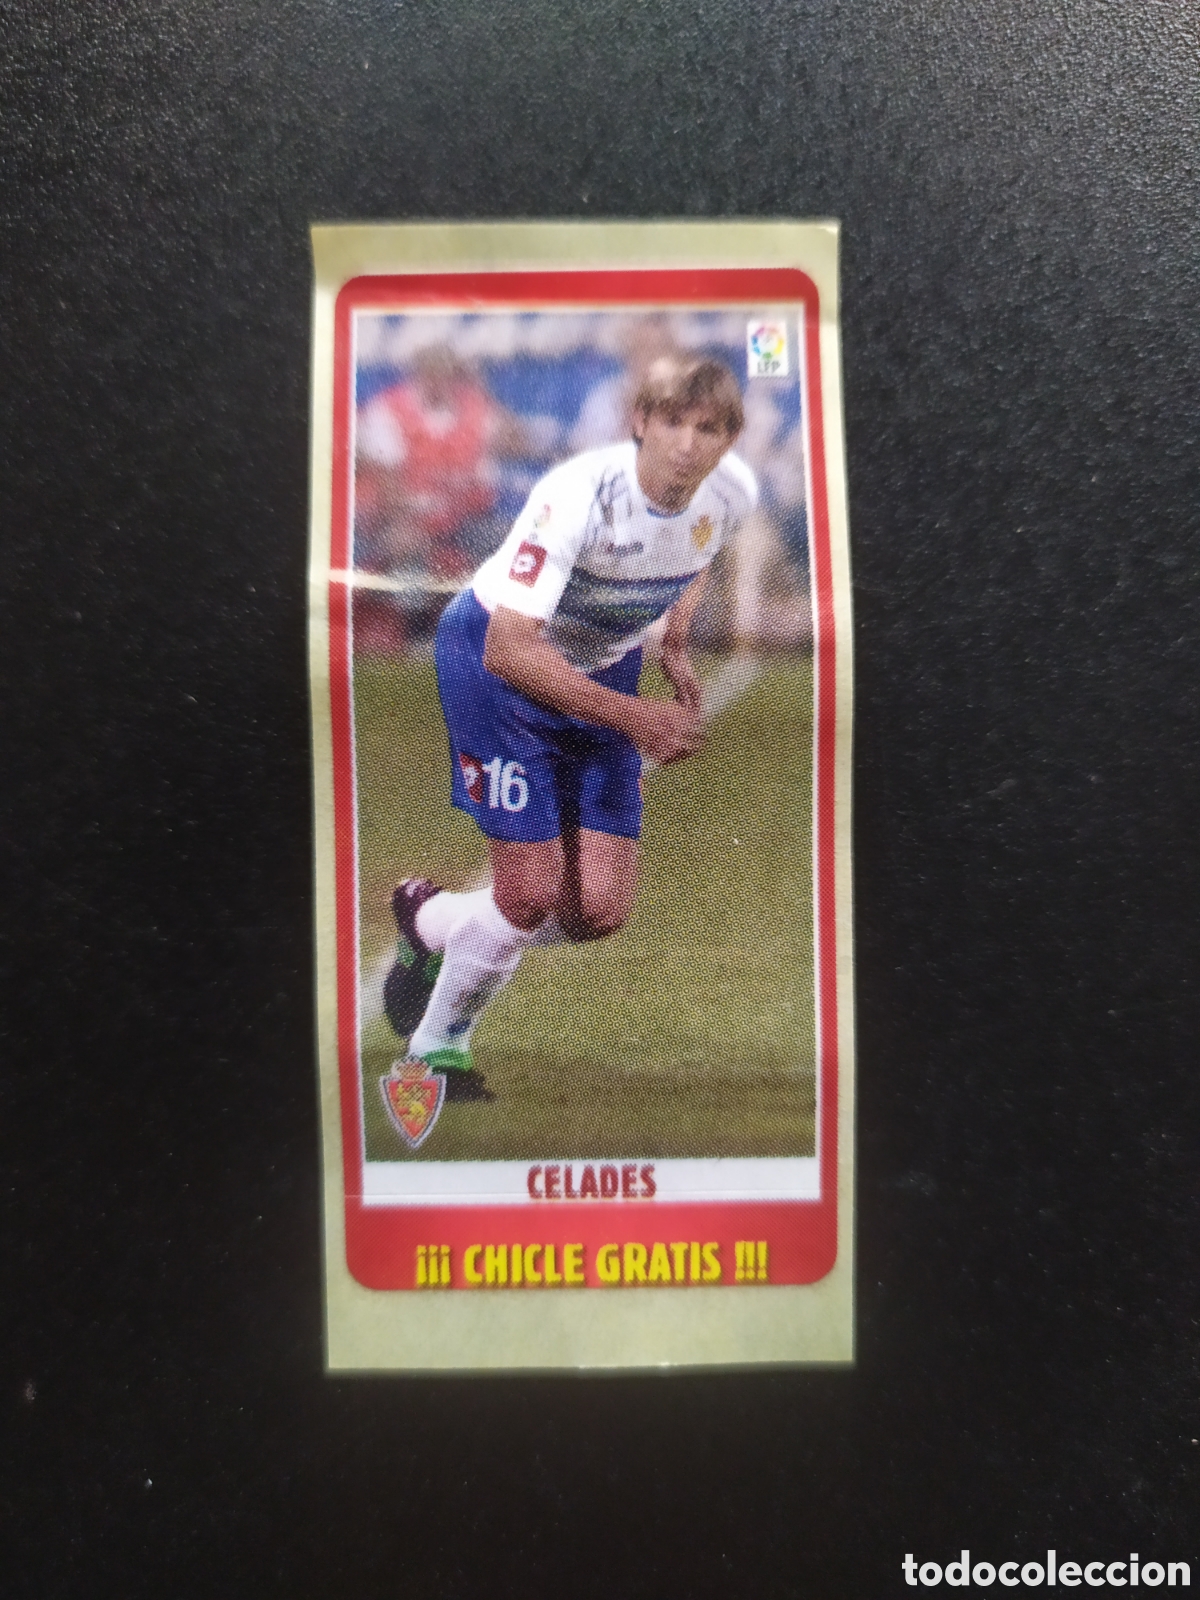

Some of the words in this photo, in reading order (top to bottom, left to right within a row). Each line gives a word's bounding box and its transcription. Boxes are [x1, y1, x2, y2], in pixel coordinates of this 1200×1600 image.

[482, 757, 528, 811] 16
[526, 1164, 657, 1200] CELADES
[464, 1243, 585, 1284] CHICLE
[597, 1241, 721, 1283] GRATIS
[735, 1240, 767, 1280] !!!
